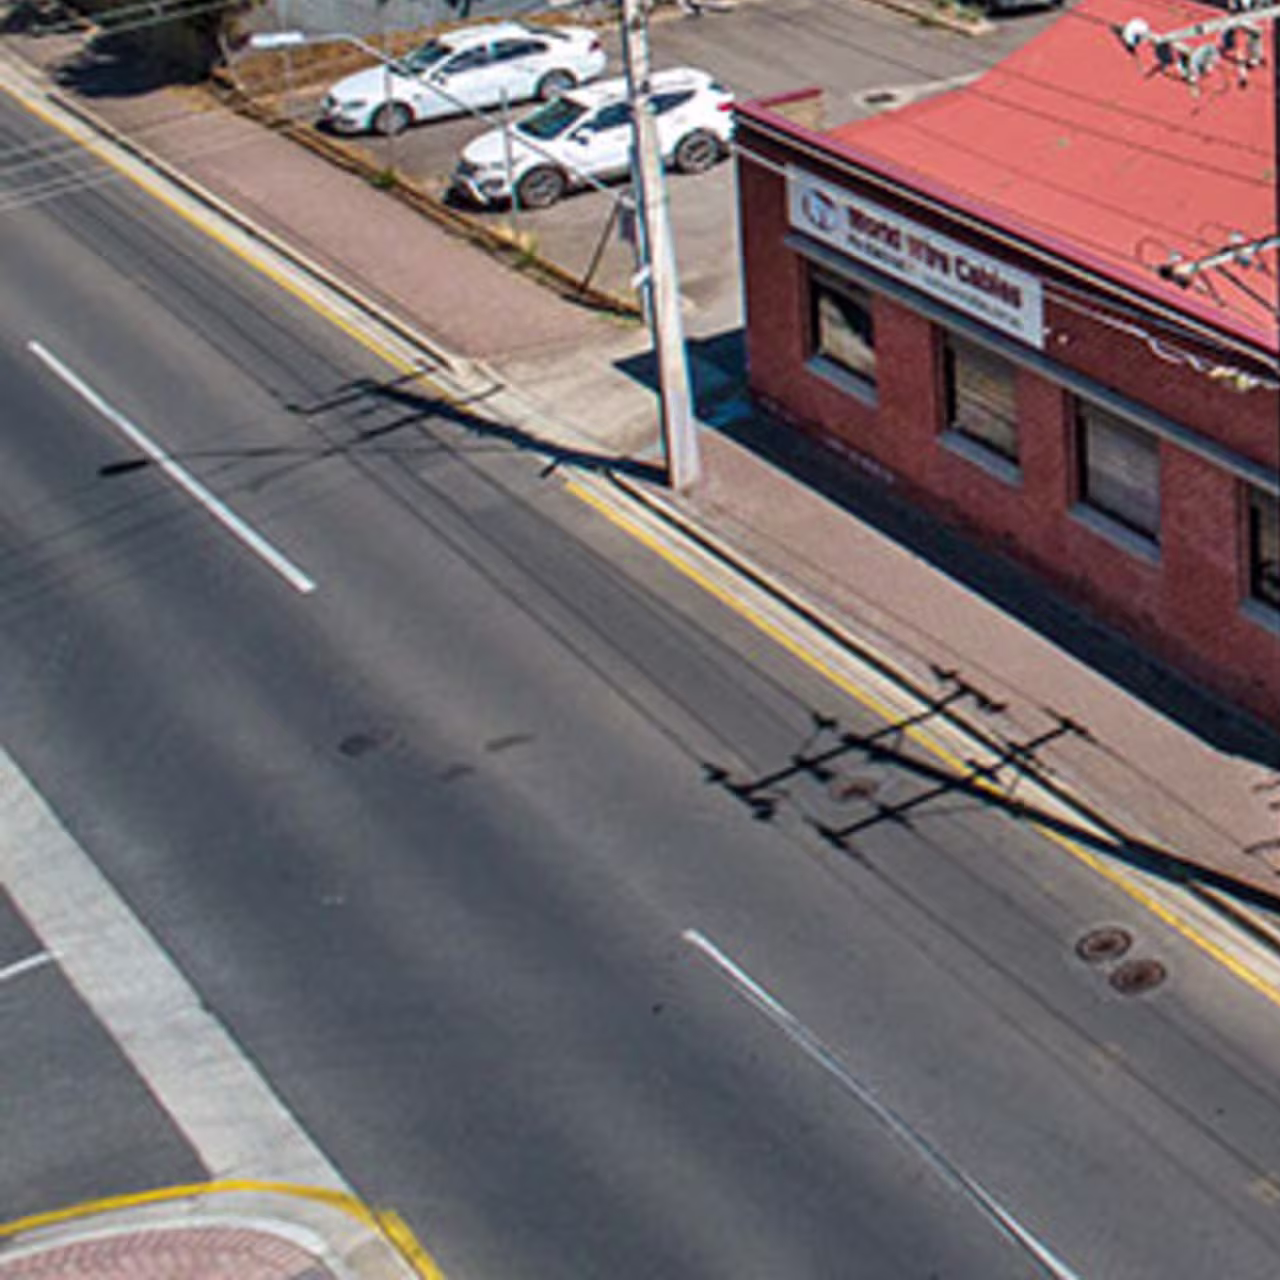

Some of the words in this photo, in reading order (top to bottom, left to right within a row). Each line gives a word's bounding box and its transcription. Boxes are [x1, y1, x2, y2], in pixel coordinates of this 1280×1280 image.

[848, 206, 902, 250] World
[907, 234, 950, 274] Wire
[956, 257, 1022, 308] Cables
